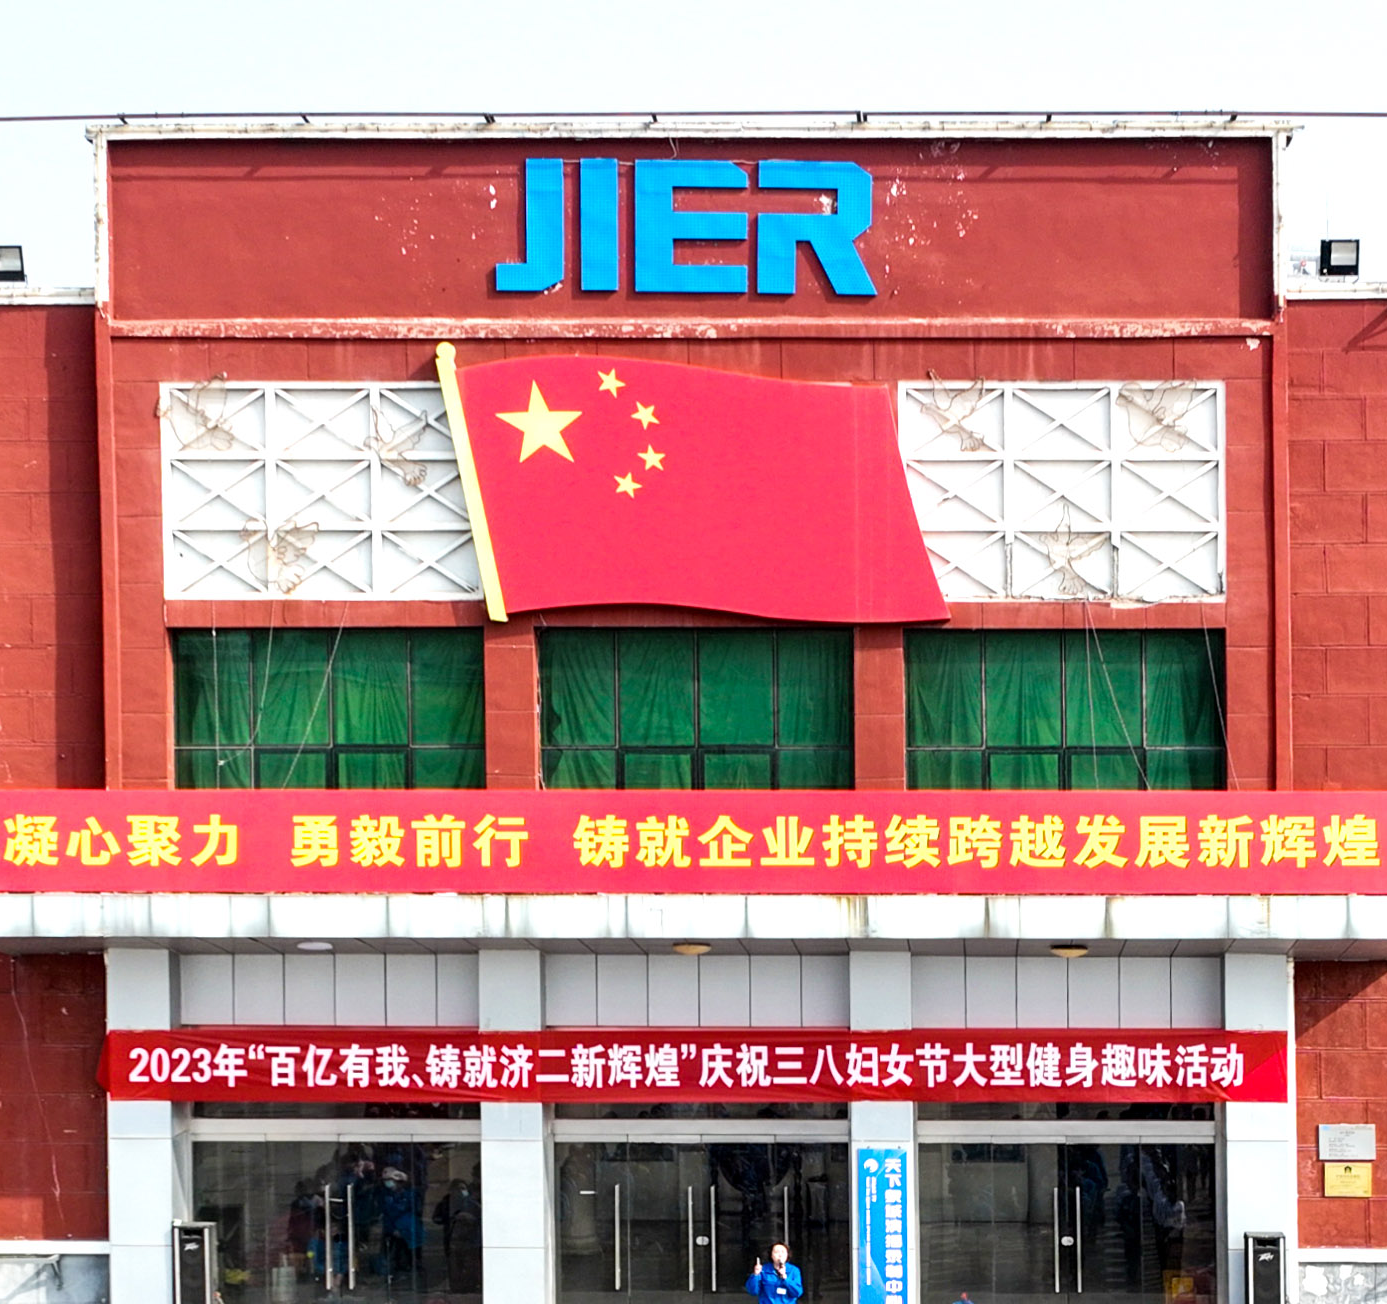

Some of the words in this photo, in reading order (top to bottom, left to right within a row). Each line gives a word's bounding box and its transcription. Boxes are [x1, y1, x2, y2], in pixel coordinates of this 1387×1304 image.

[496, 158, 877, 295] JIER
[3, 813, 239, 868] 凝心聚力
[290, 813, 529, 868] 勇毅前行
[572, 813, 1381, 869] 铸就企业持续跨越发展新辉煌
